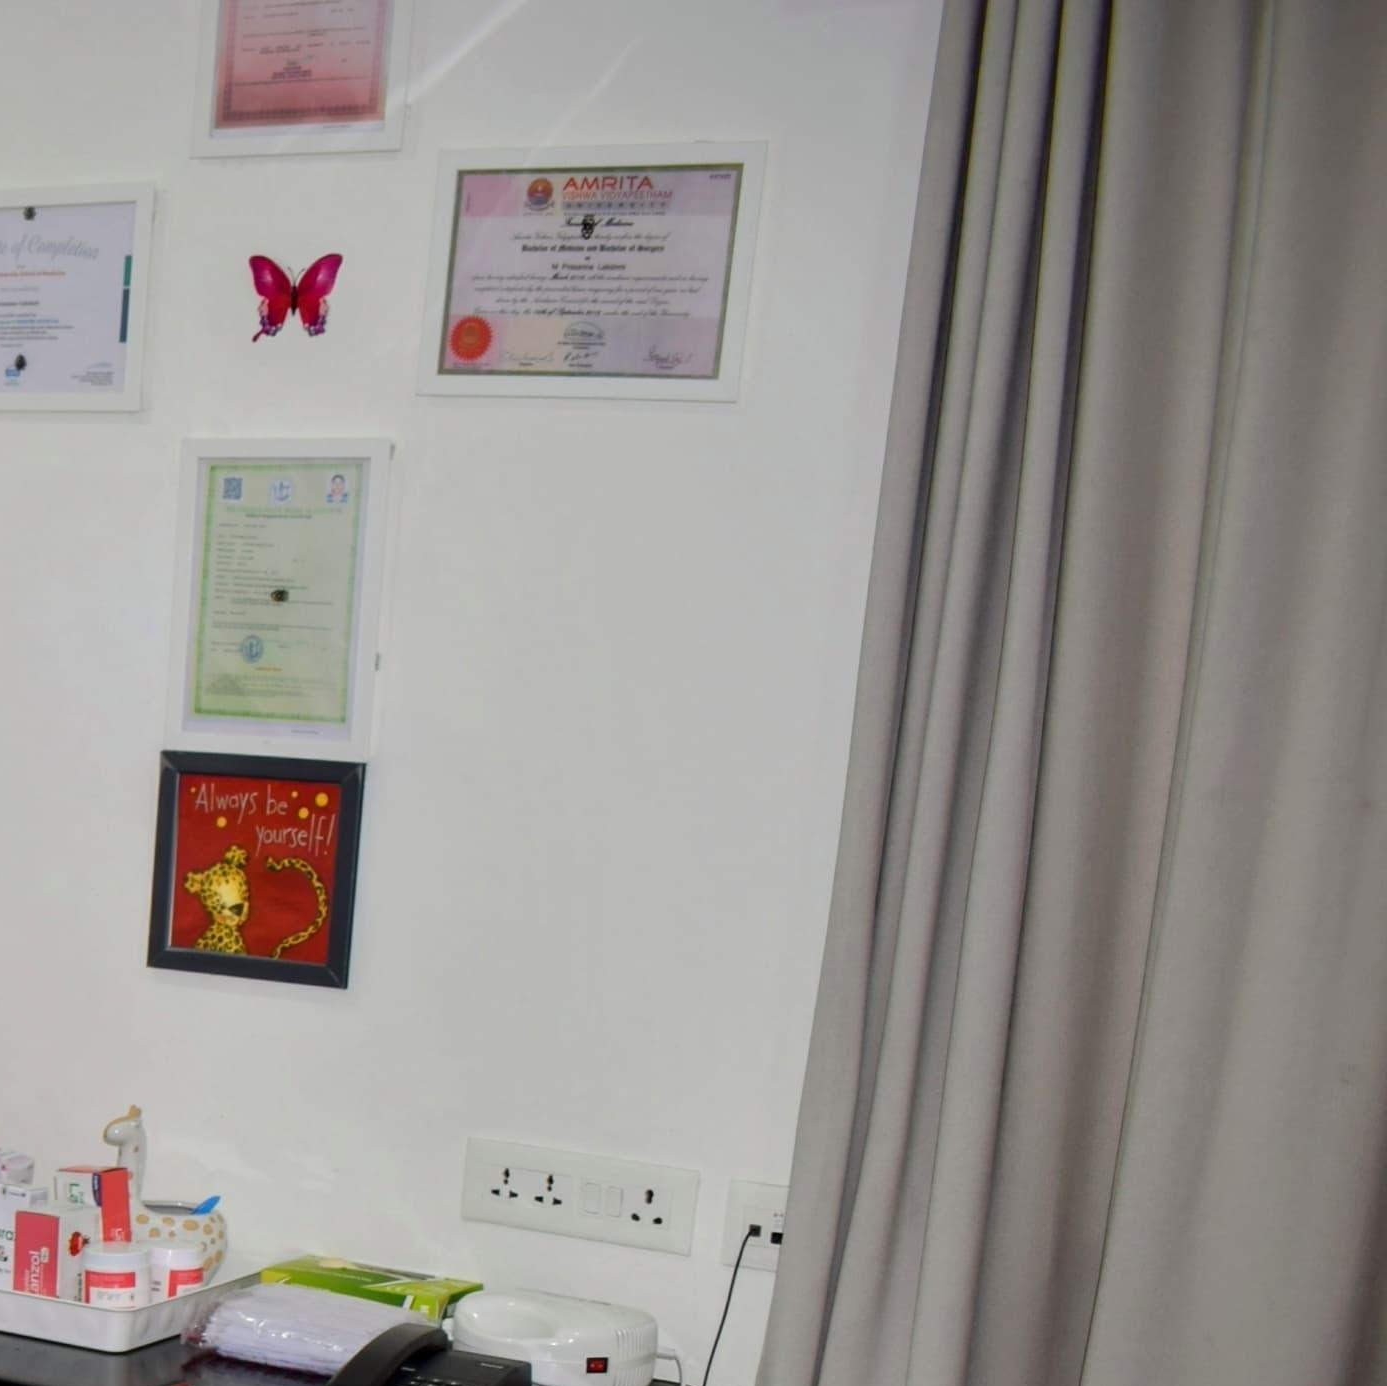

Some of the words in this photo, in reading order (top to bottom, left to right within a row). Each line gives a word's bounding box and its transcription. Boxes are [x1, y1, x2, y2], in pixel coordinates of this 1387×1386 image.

[562, 175, 654, 192] AMRITA
[194, 783, 259, 824] Always
[266, 784, 289, 816] be
[255, 813, 336, 857] yourself!
